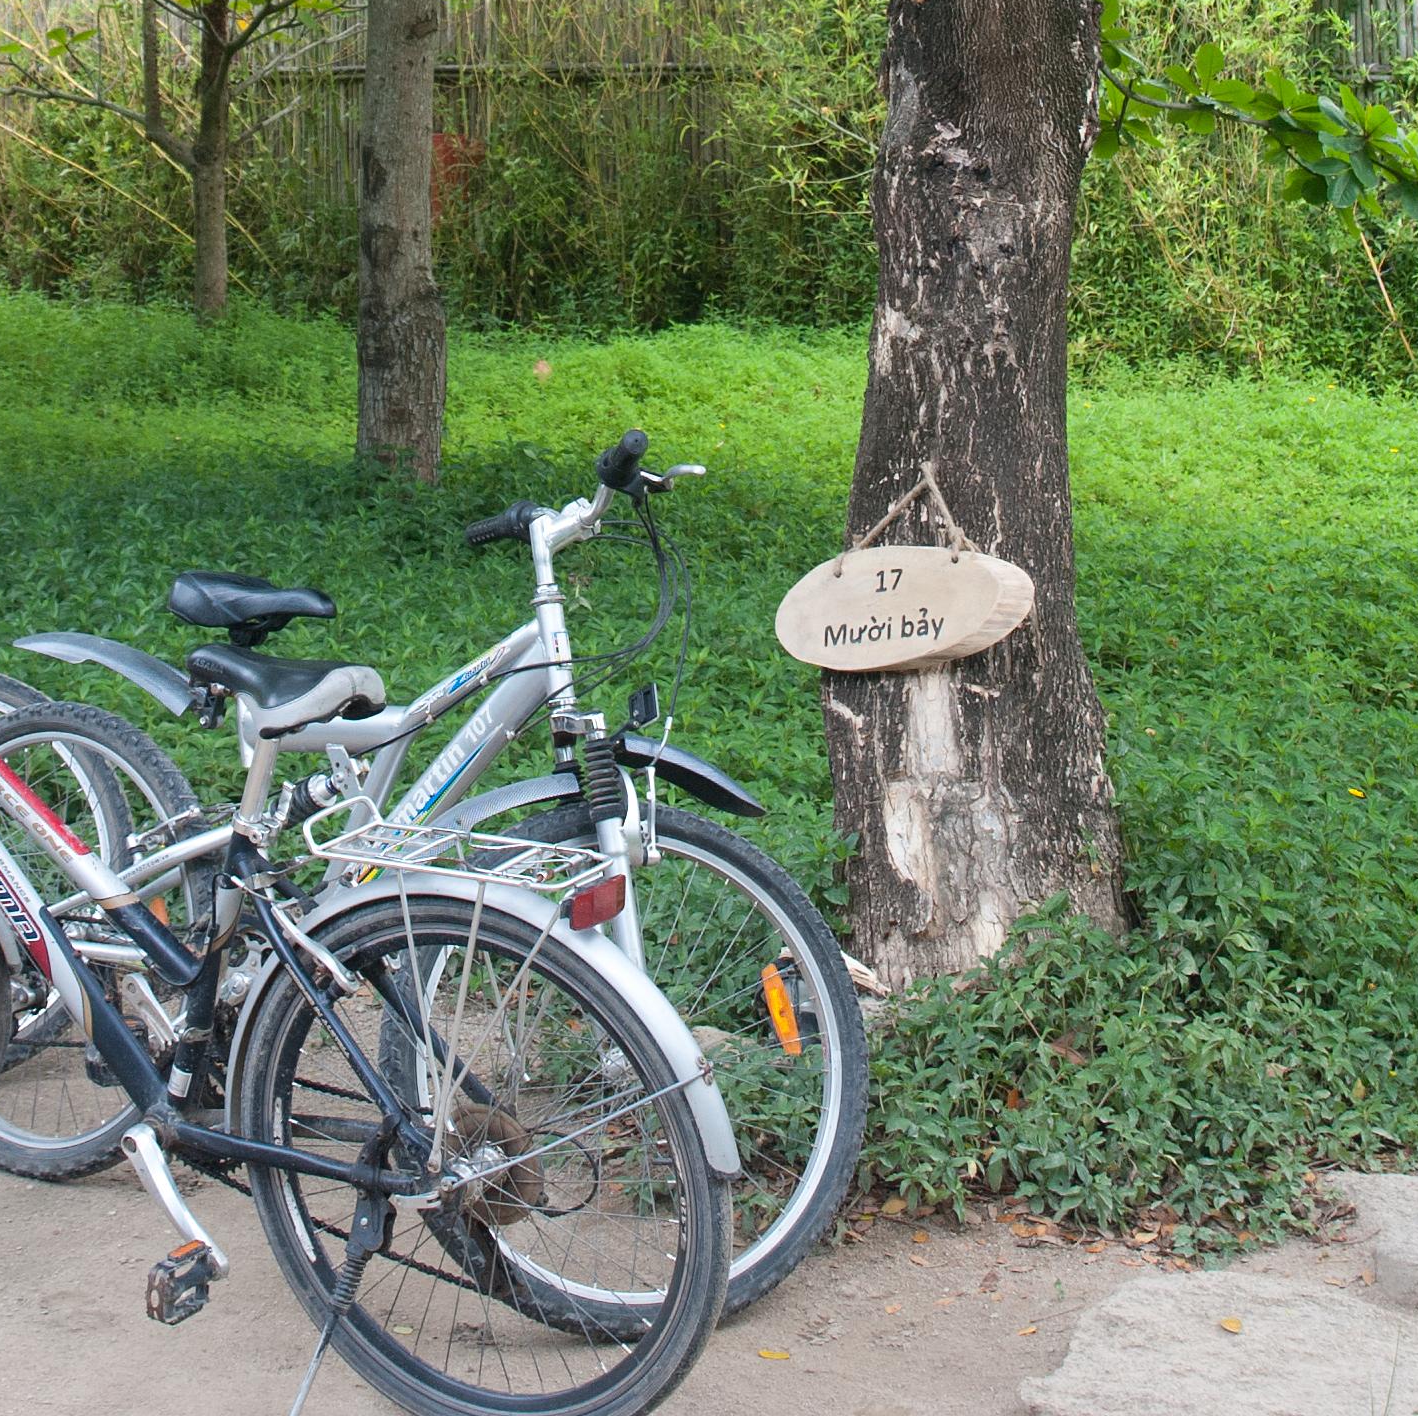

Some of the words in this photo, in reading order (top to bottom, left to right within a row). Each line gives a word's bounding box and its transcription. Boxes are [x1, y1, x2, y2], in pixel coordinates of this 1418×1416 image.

[875, 568, 903, 592] 17
[824, 616, 892, 647] Mười
[900, 607, 945, 640] bảy
[394, 746, 465, 825] martin
[465, 704, 493, 743] 107
[31, 821, 74, 864] ONE
